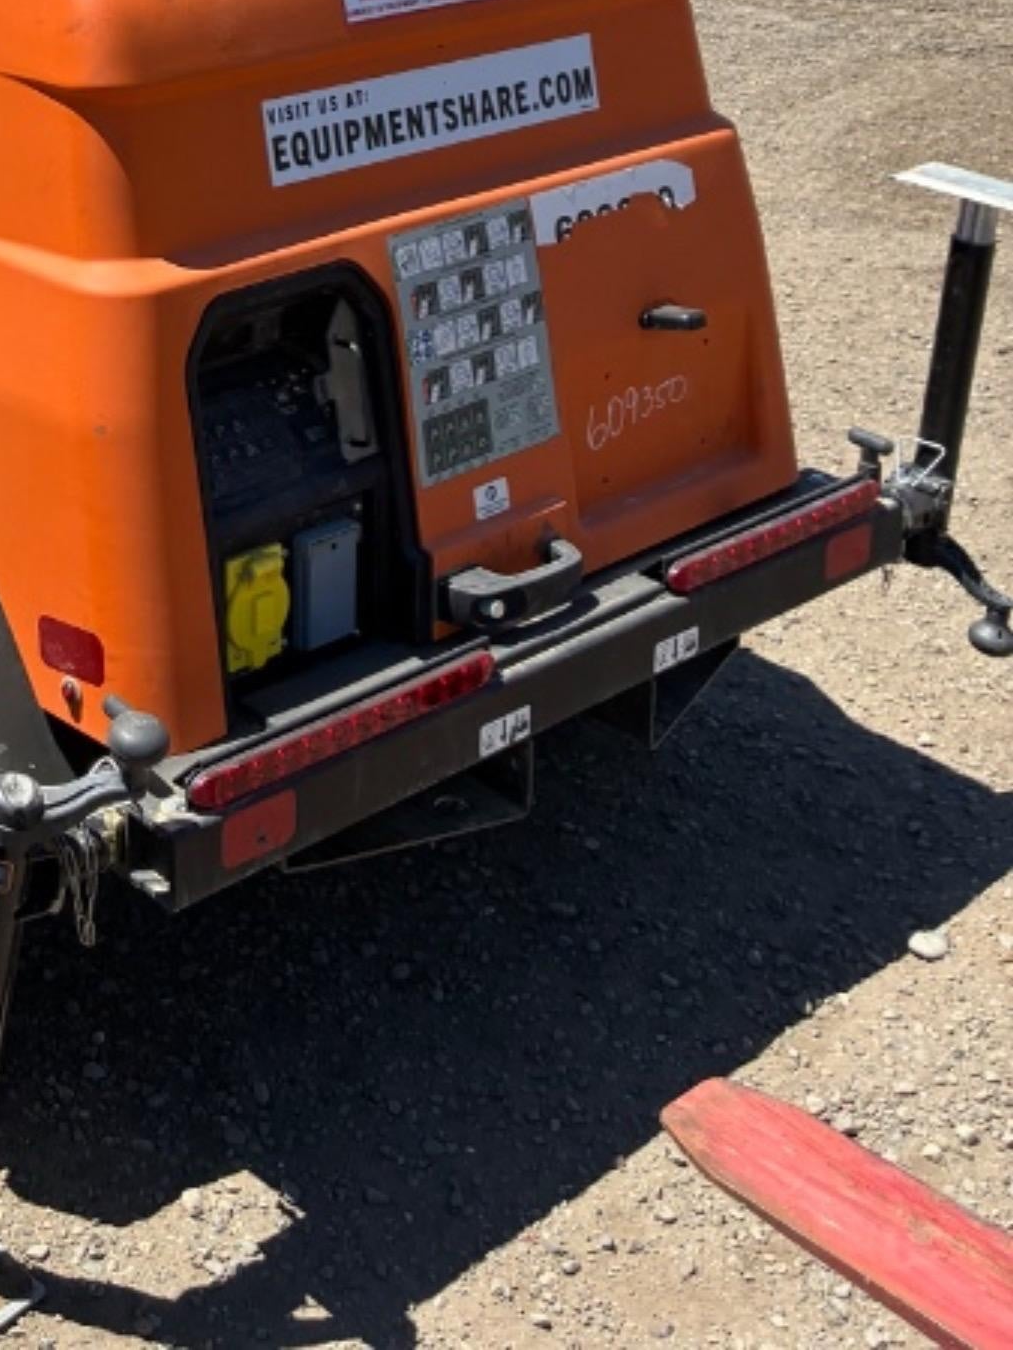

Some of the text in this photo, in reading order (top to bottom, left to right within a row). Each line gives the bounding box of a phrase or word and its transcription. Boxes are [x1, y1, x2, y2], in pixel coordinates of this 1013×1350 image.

[267, 89, 369, 125] VISIT US AT:
[272, 65, 594, 171] EQUIPMENTSHARE.COM
[587, 374, 687, 451] 609350
